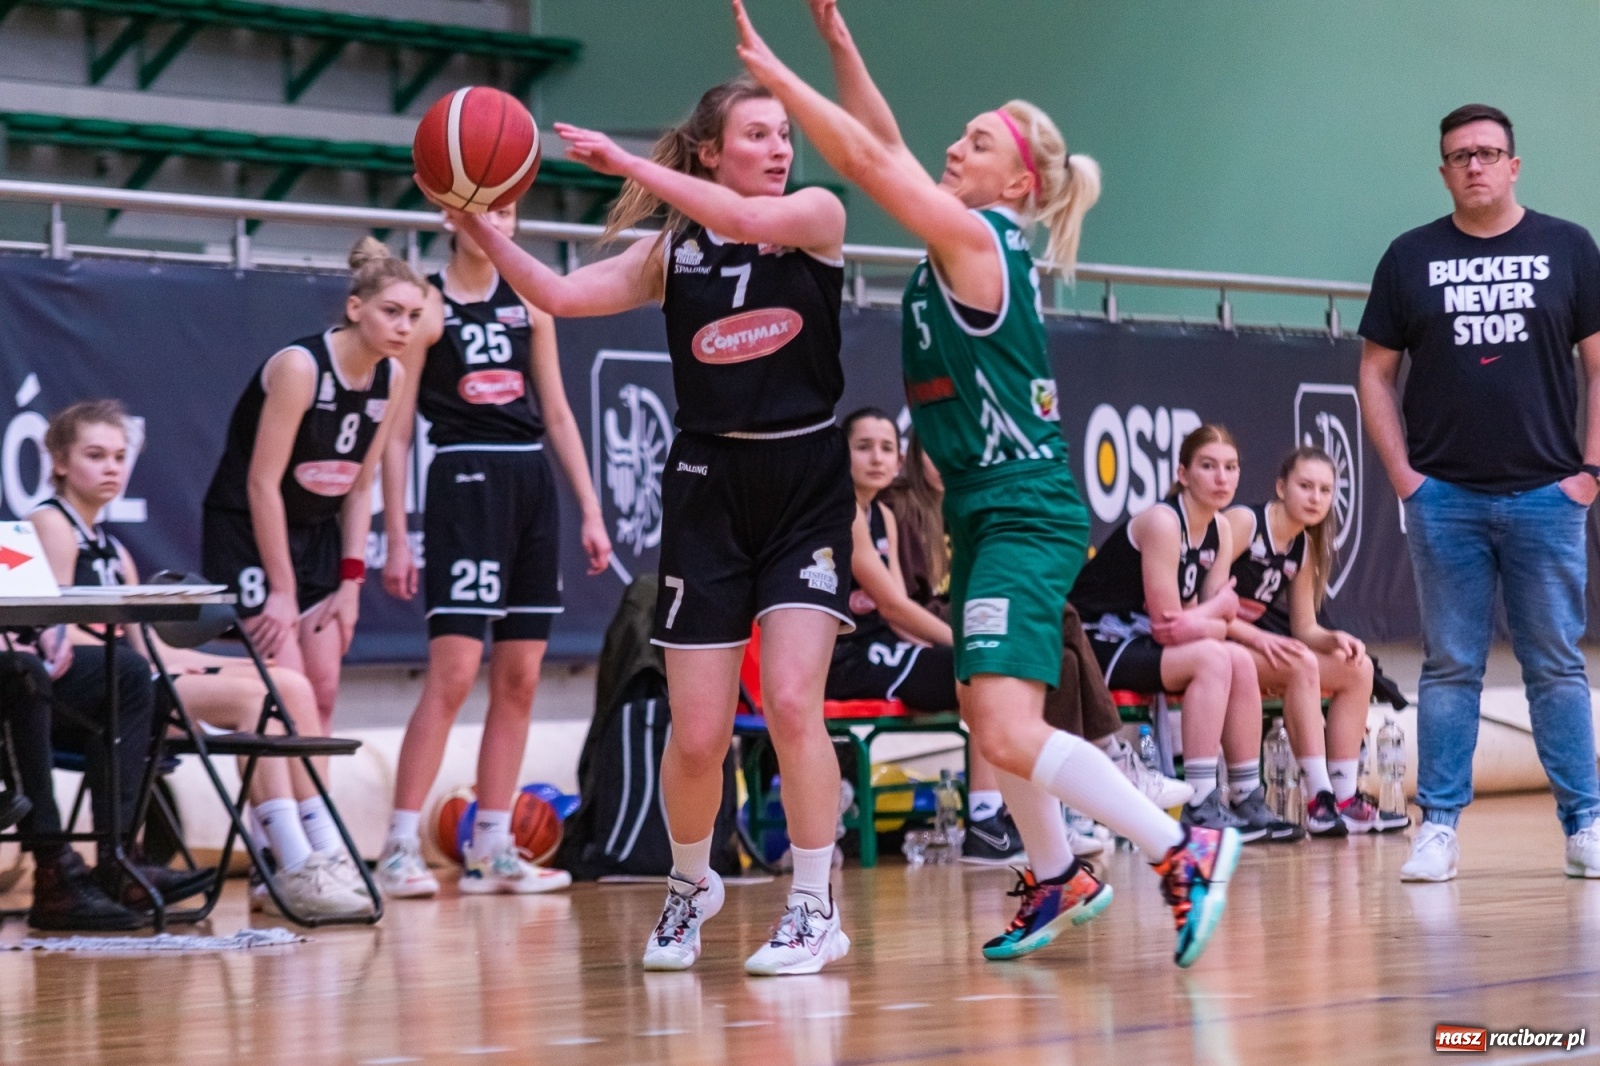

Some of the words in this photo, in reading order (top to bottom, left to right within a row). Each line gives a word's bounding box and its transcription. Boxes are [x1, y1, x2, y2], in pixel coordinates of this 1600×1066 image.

[674, 264, 712, 274] SPALDING
[720, 263, 752, 309] 7
[1429, 255, 1550, 286] BUCKETS
[1444, 282, 1536, 313] NEVER
[461, 322, 512, 364] 25
[701, 322, 789, 355] CONTIMAX
[911, 300, 931, 350] 5
[1453, 313, 1529, 346] STOP.
[335, 412, 361, 454] 8
[238, 566, 266, 608] 8
[451, 559, 500, 603] 25
[802, 570, 834, 583] FISHER
[811, 579, 835, 592] KING
[1183, 563, 1197, 599] 9
[1254, 567, 1281, 603] 12
[665, 575, 684, 629] 7
